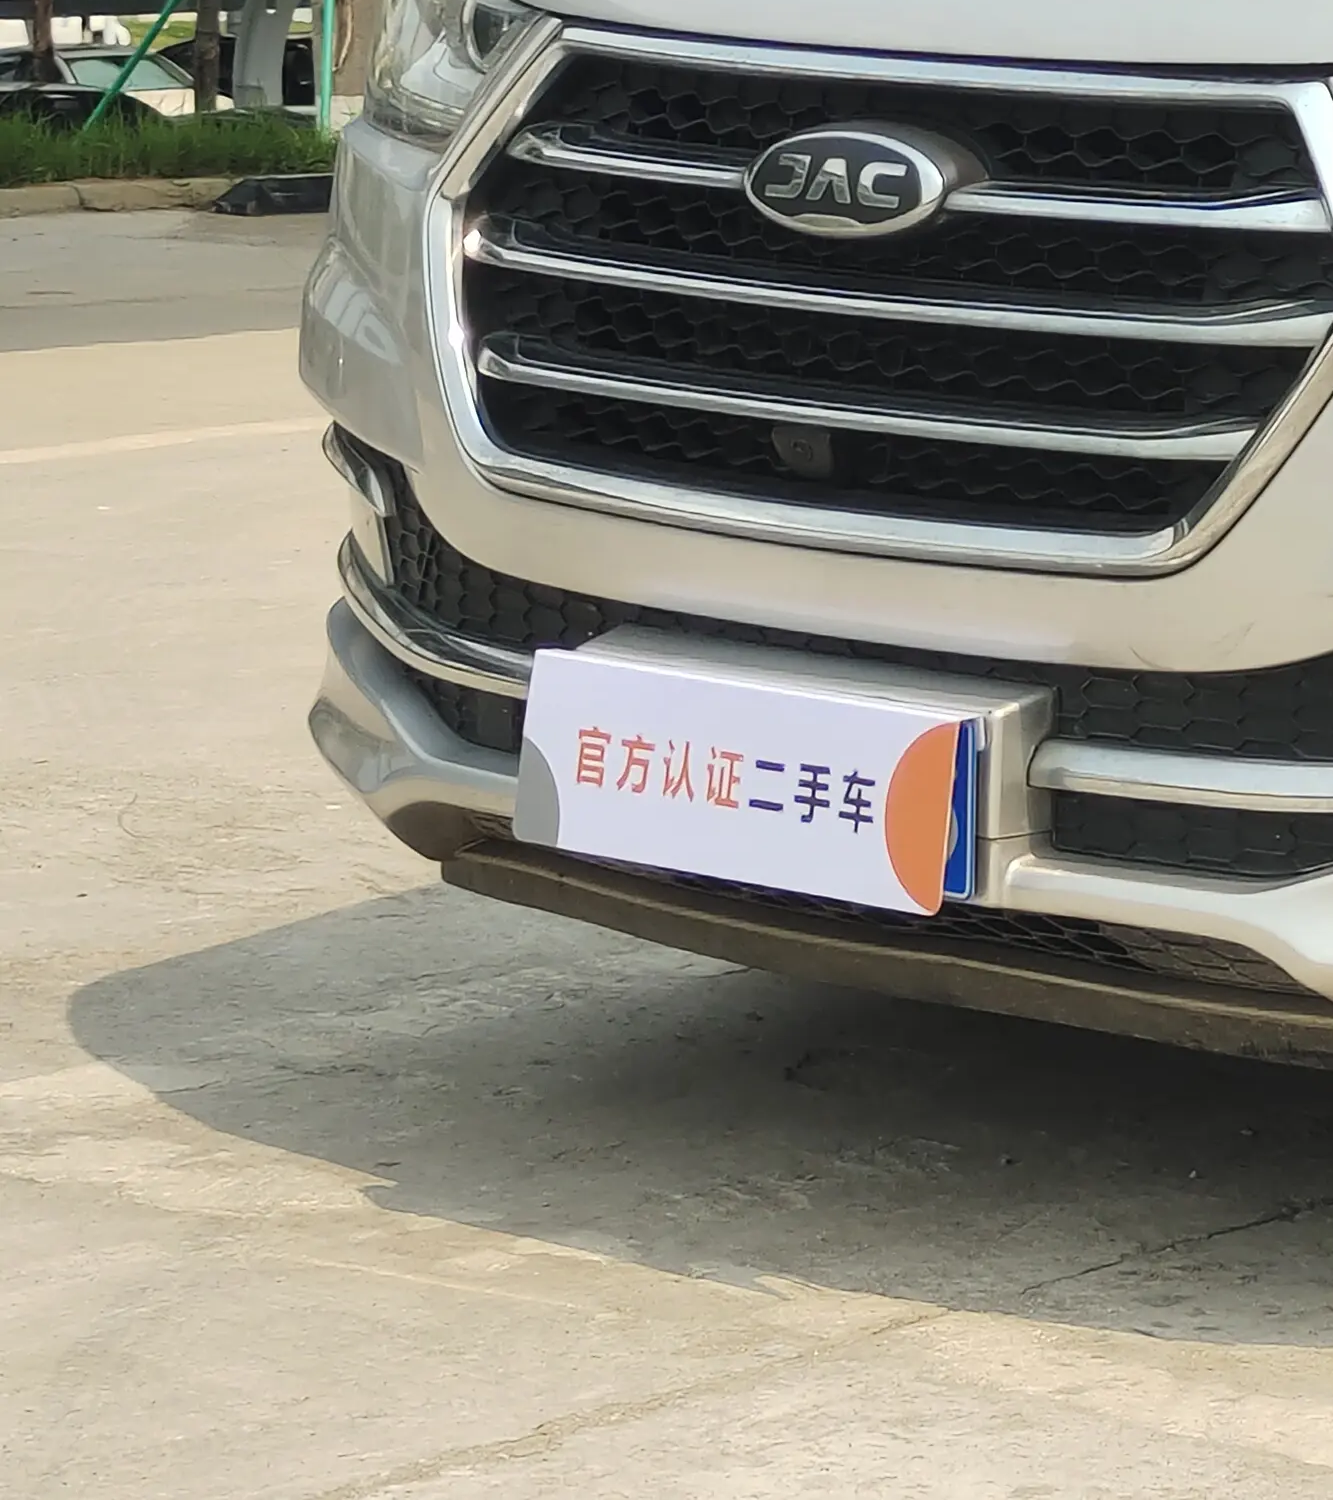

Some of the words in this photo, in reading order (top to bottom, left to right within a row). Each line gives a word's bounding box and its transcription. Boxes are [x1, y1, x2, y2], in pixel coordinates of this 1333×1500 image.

[764, 152, 908, 210] JAC
[574, 724, 877, 834] 官方认证二手车
